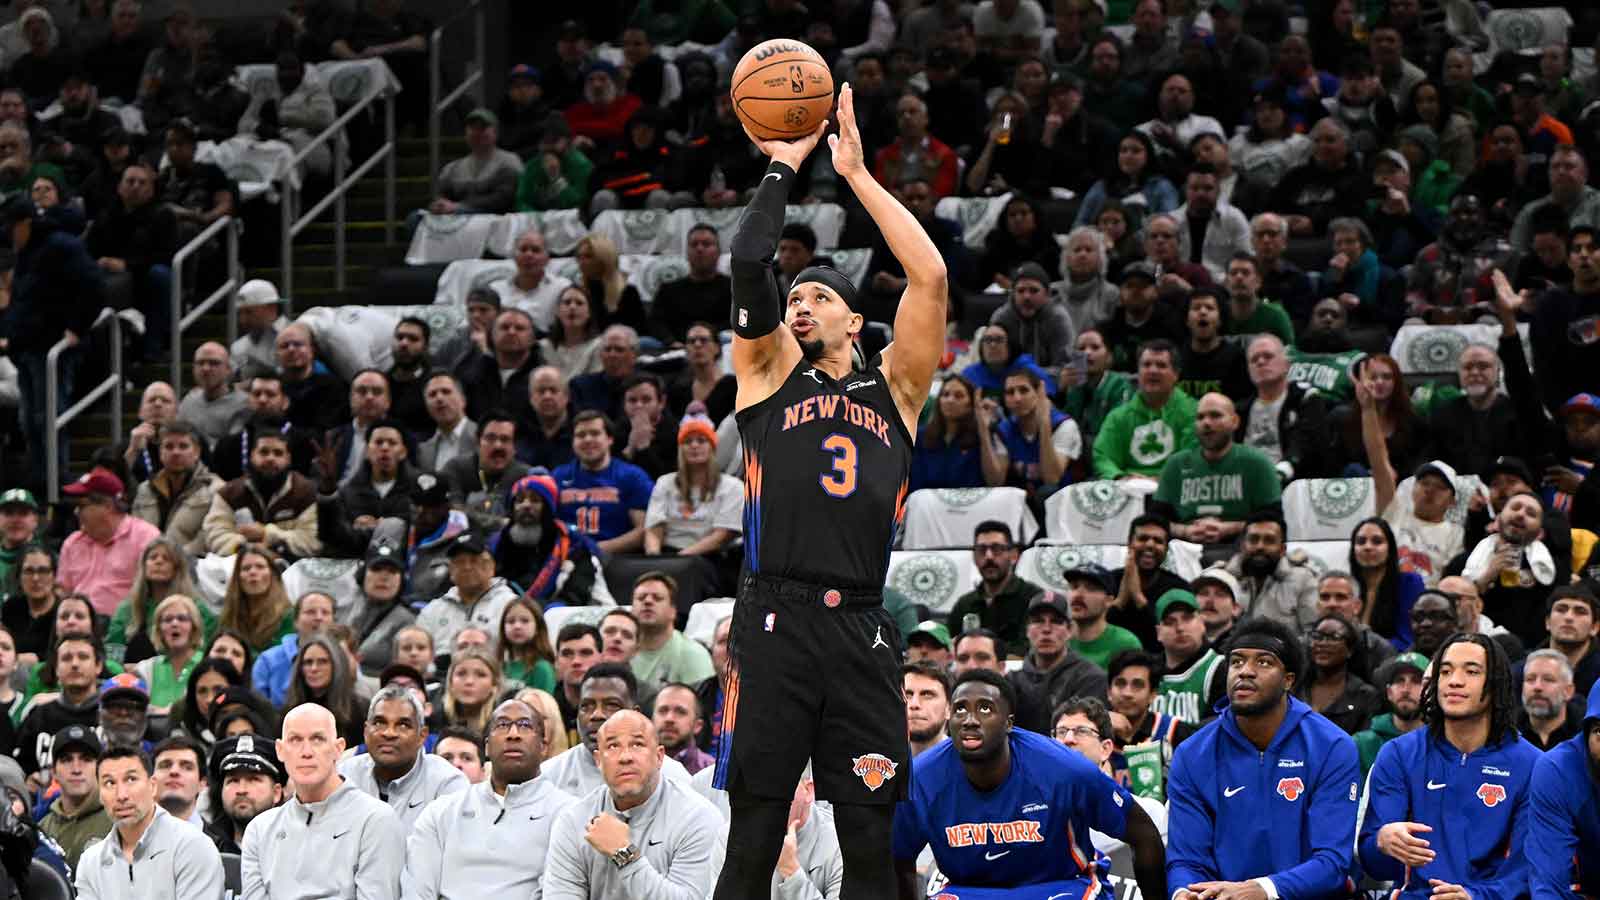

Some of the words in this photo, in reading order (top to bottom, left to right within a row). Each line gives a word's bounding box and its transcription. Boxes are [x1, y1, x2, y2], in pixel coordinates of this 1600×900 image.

[1287, 362, 1340, 391] OSTON
[782, 394, 840, 431] NEW
[841, 395, 891, 448] YORK
[818, 432, 858, 499] 3
[1180, 473, 1243, 504] BOSTON
[576, 506, 600, 534] 11
[945, 823, 988, 848] NEW
[989, 820, 1044, 844] YORK
